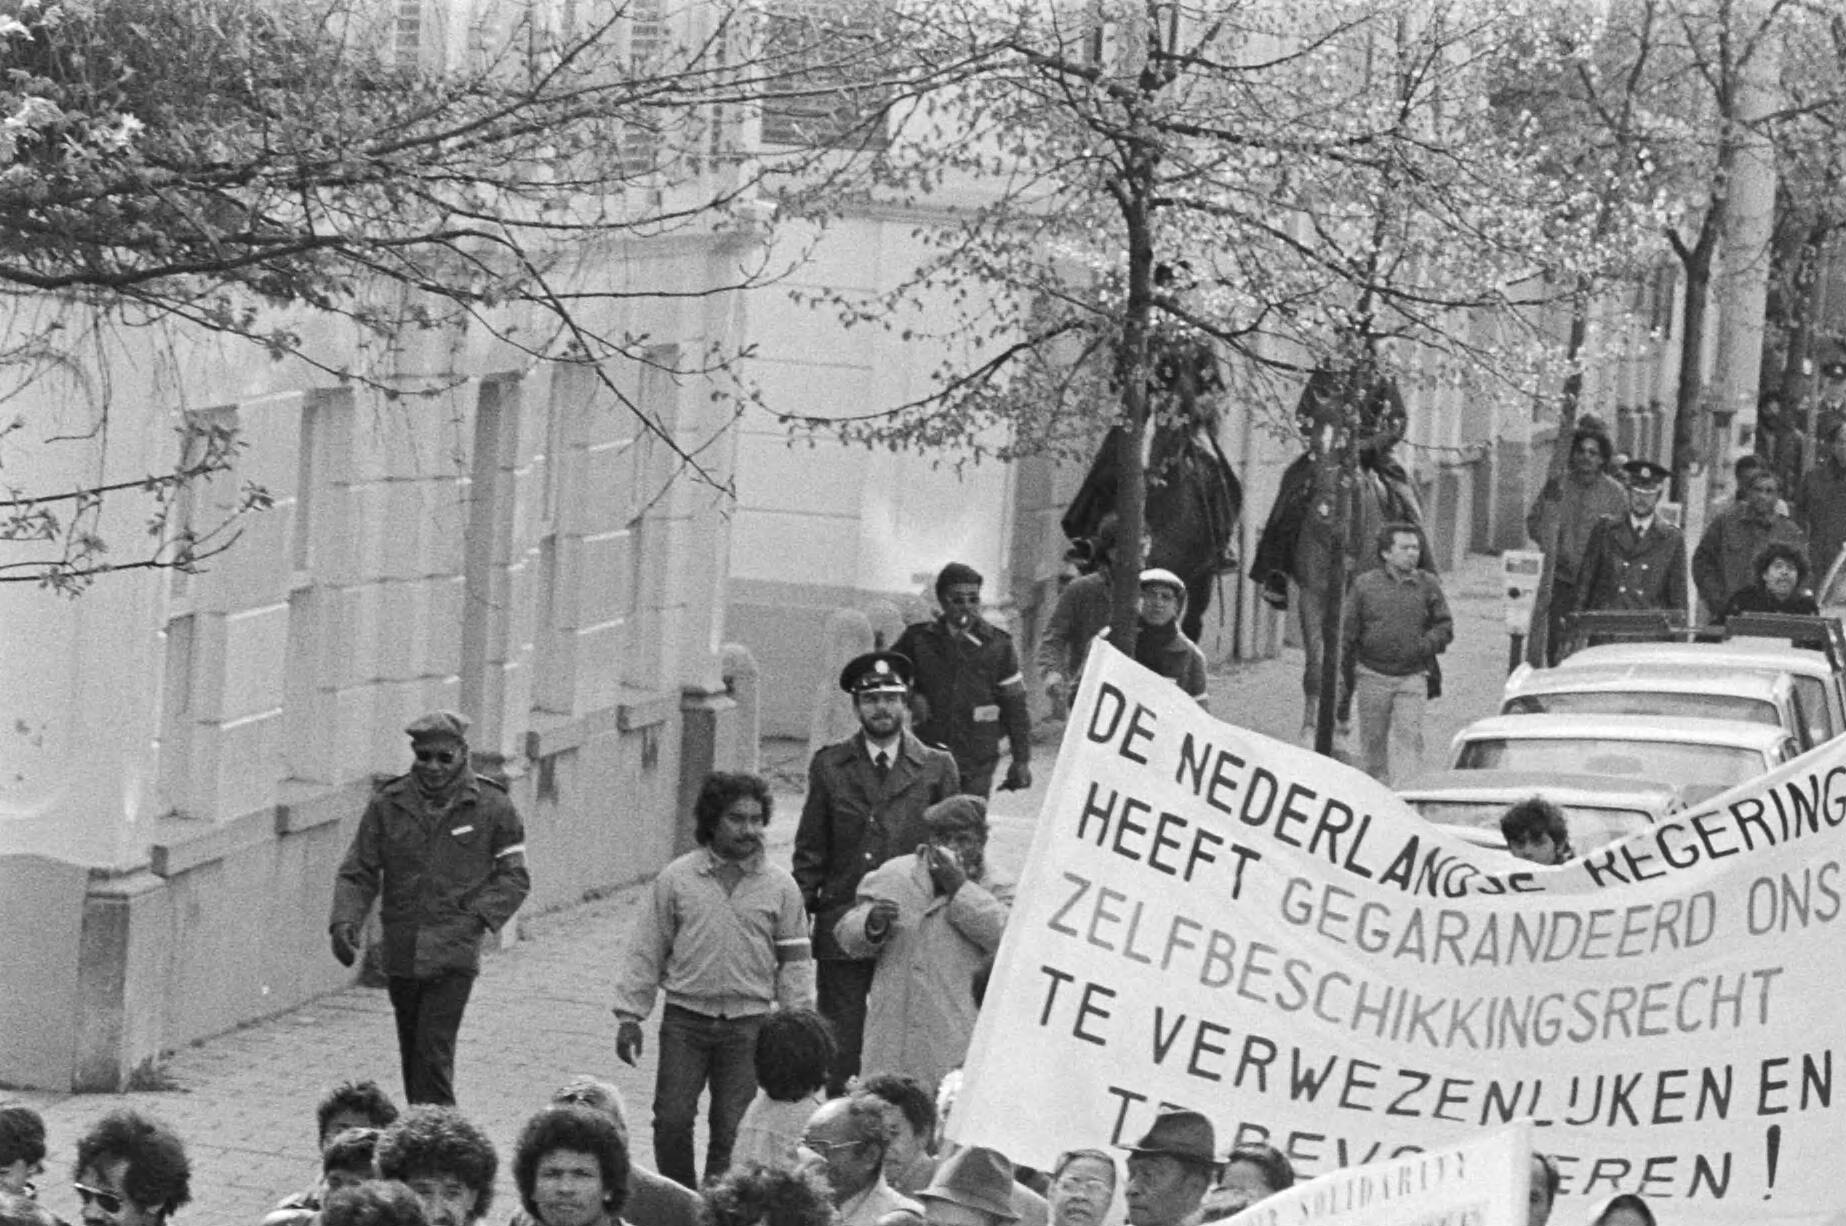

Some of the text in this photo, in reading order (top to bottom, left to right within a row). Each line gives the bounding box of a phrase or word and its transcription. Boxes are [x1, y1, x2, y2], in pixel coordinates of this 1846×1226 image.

[1076, 782, 1841, 968] HEEFT GEGARANDEERD ONS
[1087, 682, 1156, 764] DE
[1176, 734, 1548, 898] NEDERLANDSE
[1039, 967, 1115, 1047] TE
[1757, 1049, 1834, 1116] EN
[1048, 871, 1785, 1050] ZELFBESCHIKKINGSRECHT
